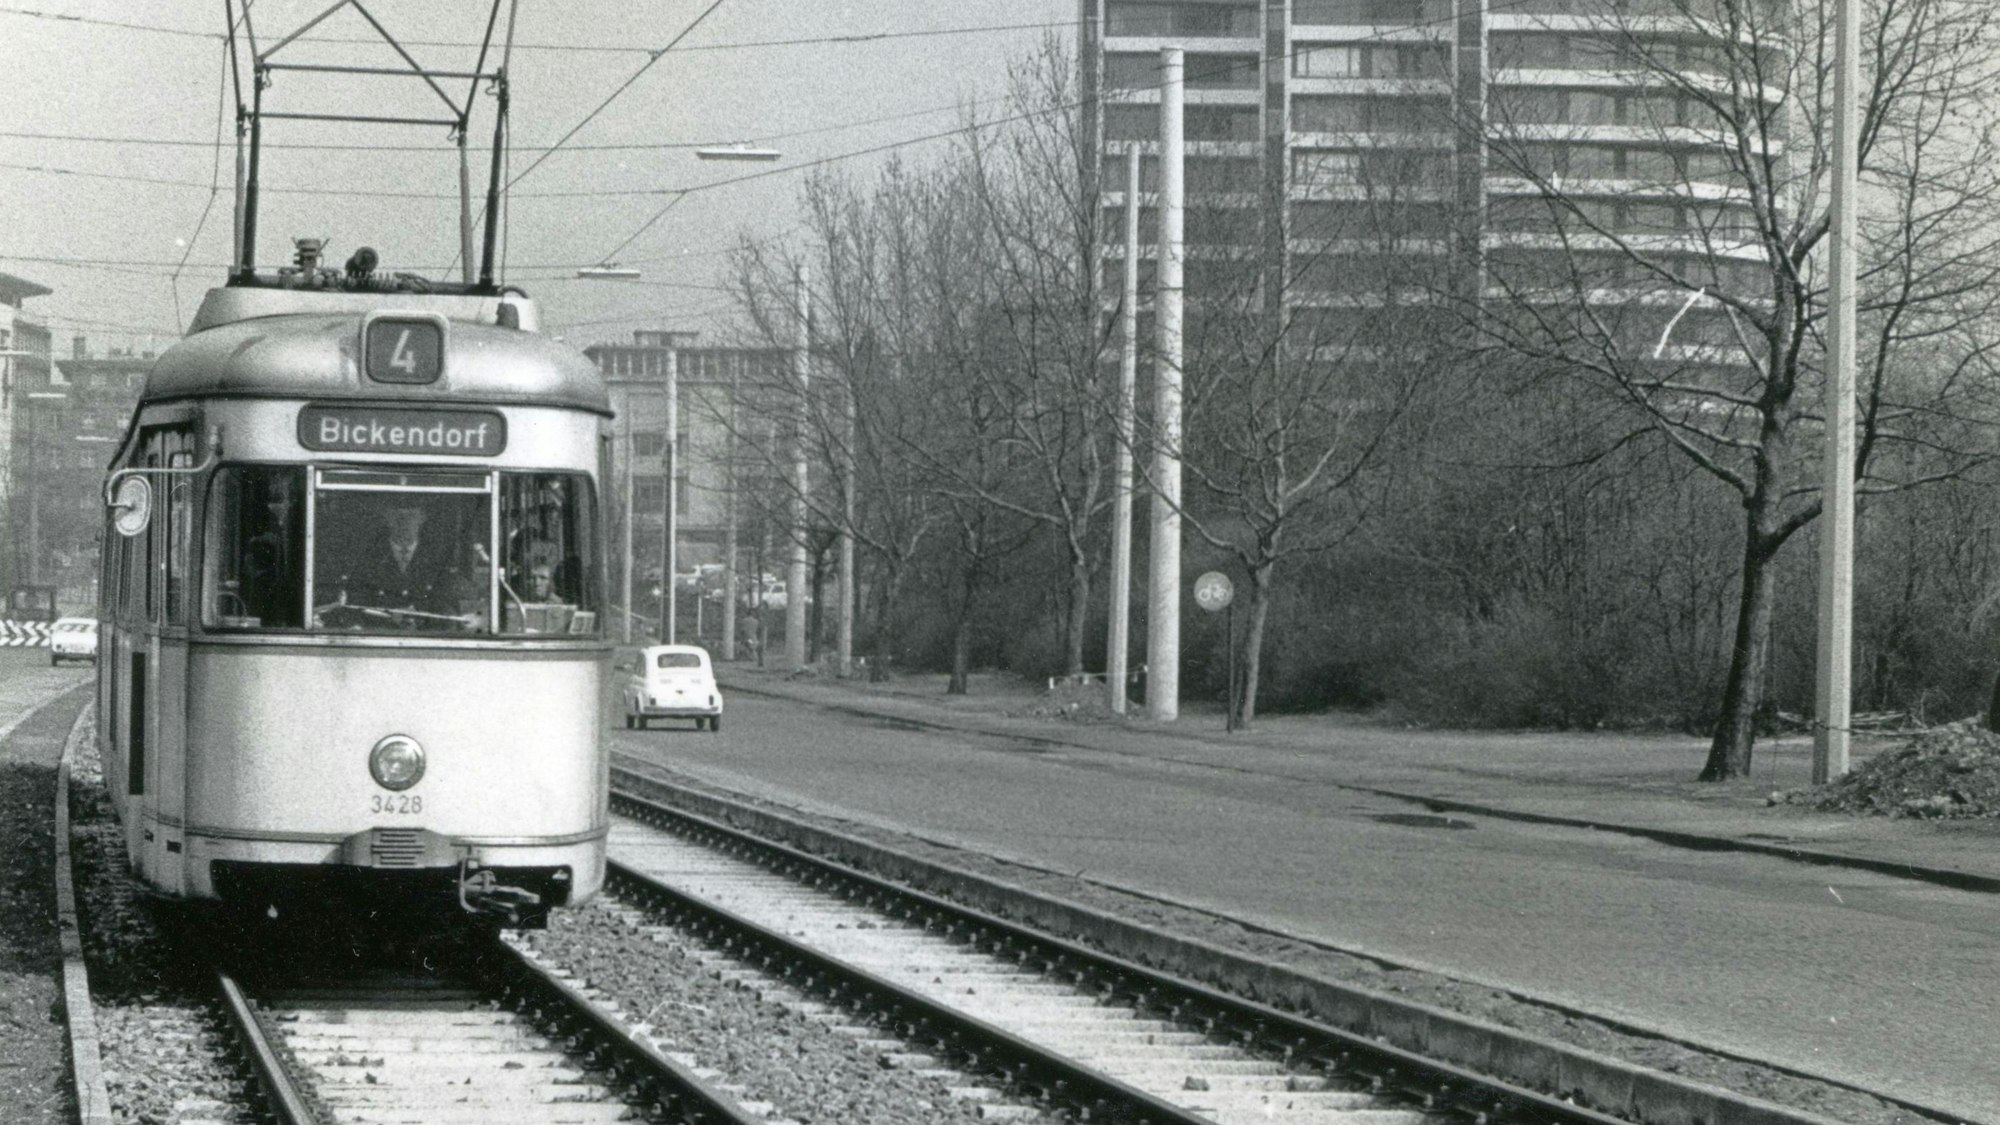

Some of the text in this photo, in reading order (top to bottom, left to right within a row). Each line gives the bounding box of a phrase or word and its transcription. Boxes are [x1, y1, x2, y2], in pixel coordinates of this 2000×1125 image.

[389, 328, 417, 374] 4
[319, 416, 489, 449] Bickendorf
[370, 794, 423, 815] 3428
